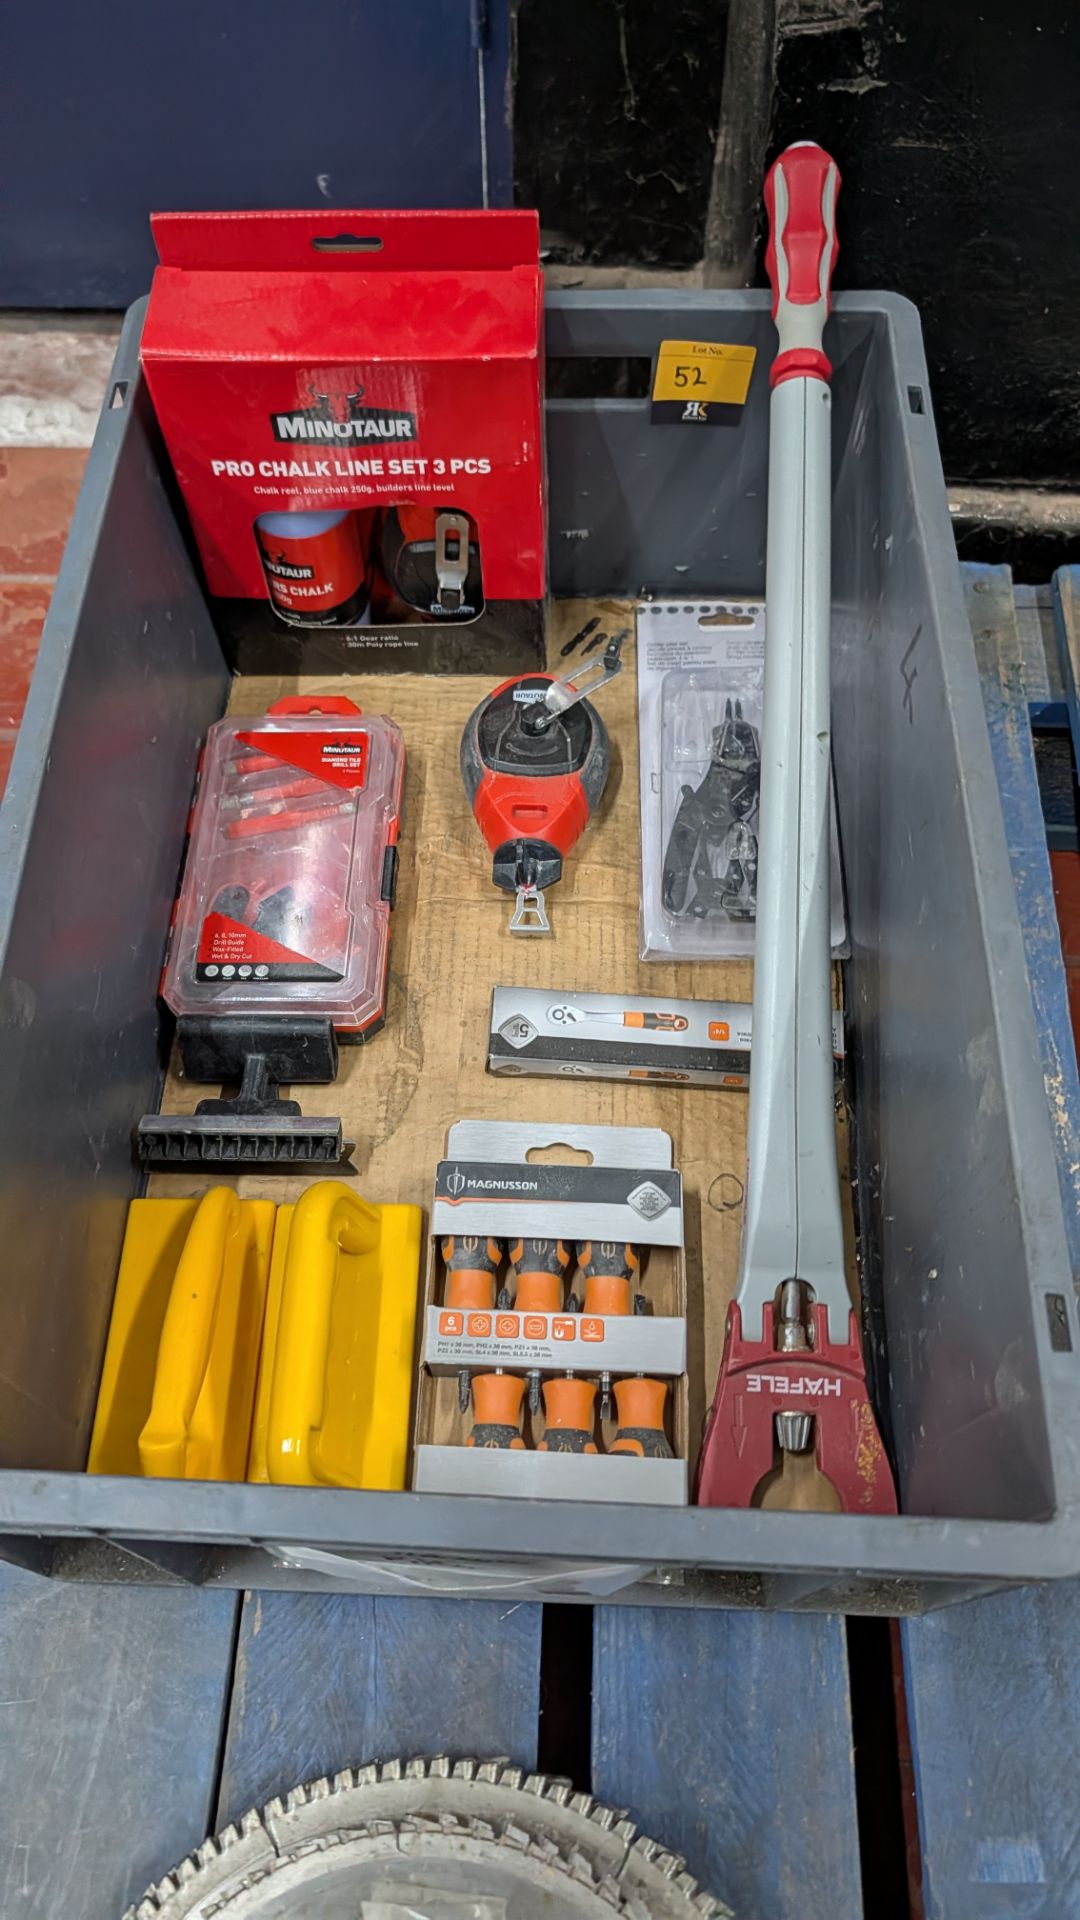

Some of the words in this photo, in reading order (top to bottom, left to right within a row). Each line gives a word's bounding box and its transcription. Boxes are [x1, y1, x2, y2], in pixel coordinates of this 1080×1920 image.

[674, 366, 708, 388] 52
[276, 416, 412, 439] MINOTAUR
[211, 460, 255, 478] PRO
[259, 460, 331, 477] CHALK
[335, 460, 384, 476] LINE
[388, 459, 428, 475] SET
[433, 459, 446, 474] 3
[450, 459, 492, 475] PCS
[254, 486, 279, 495] Chalk
[304, 486, 323, 495] blue
[325, 485, 349, 494] chalk
[376, 484, 413, 493] builders
[414, 483, 431, 492] line
[432, 483, 455, 492] level
[289, 582, 334, 597] CHALK
[230, 953, 241, 961] Dry
[519, 1023, 529, 1038] 5
[467, 1179, 538, 1191] MAGNUSSON
[447, 1316, 456, 1326] 6
[746, 1373, 842, 1397] HÄFELE
